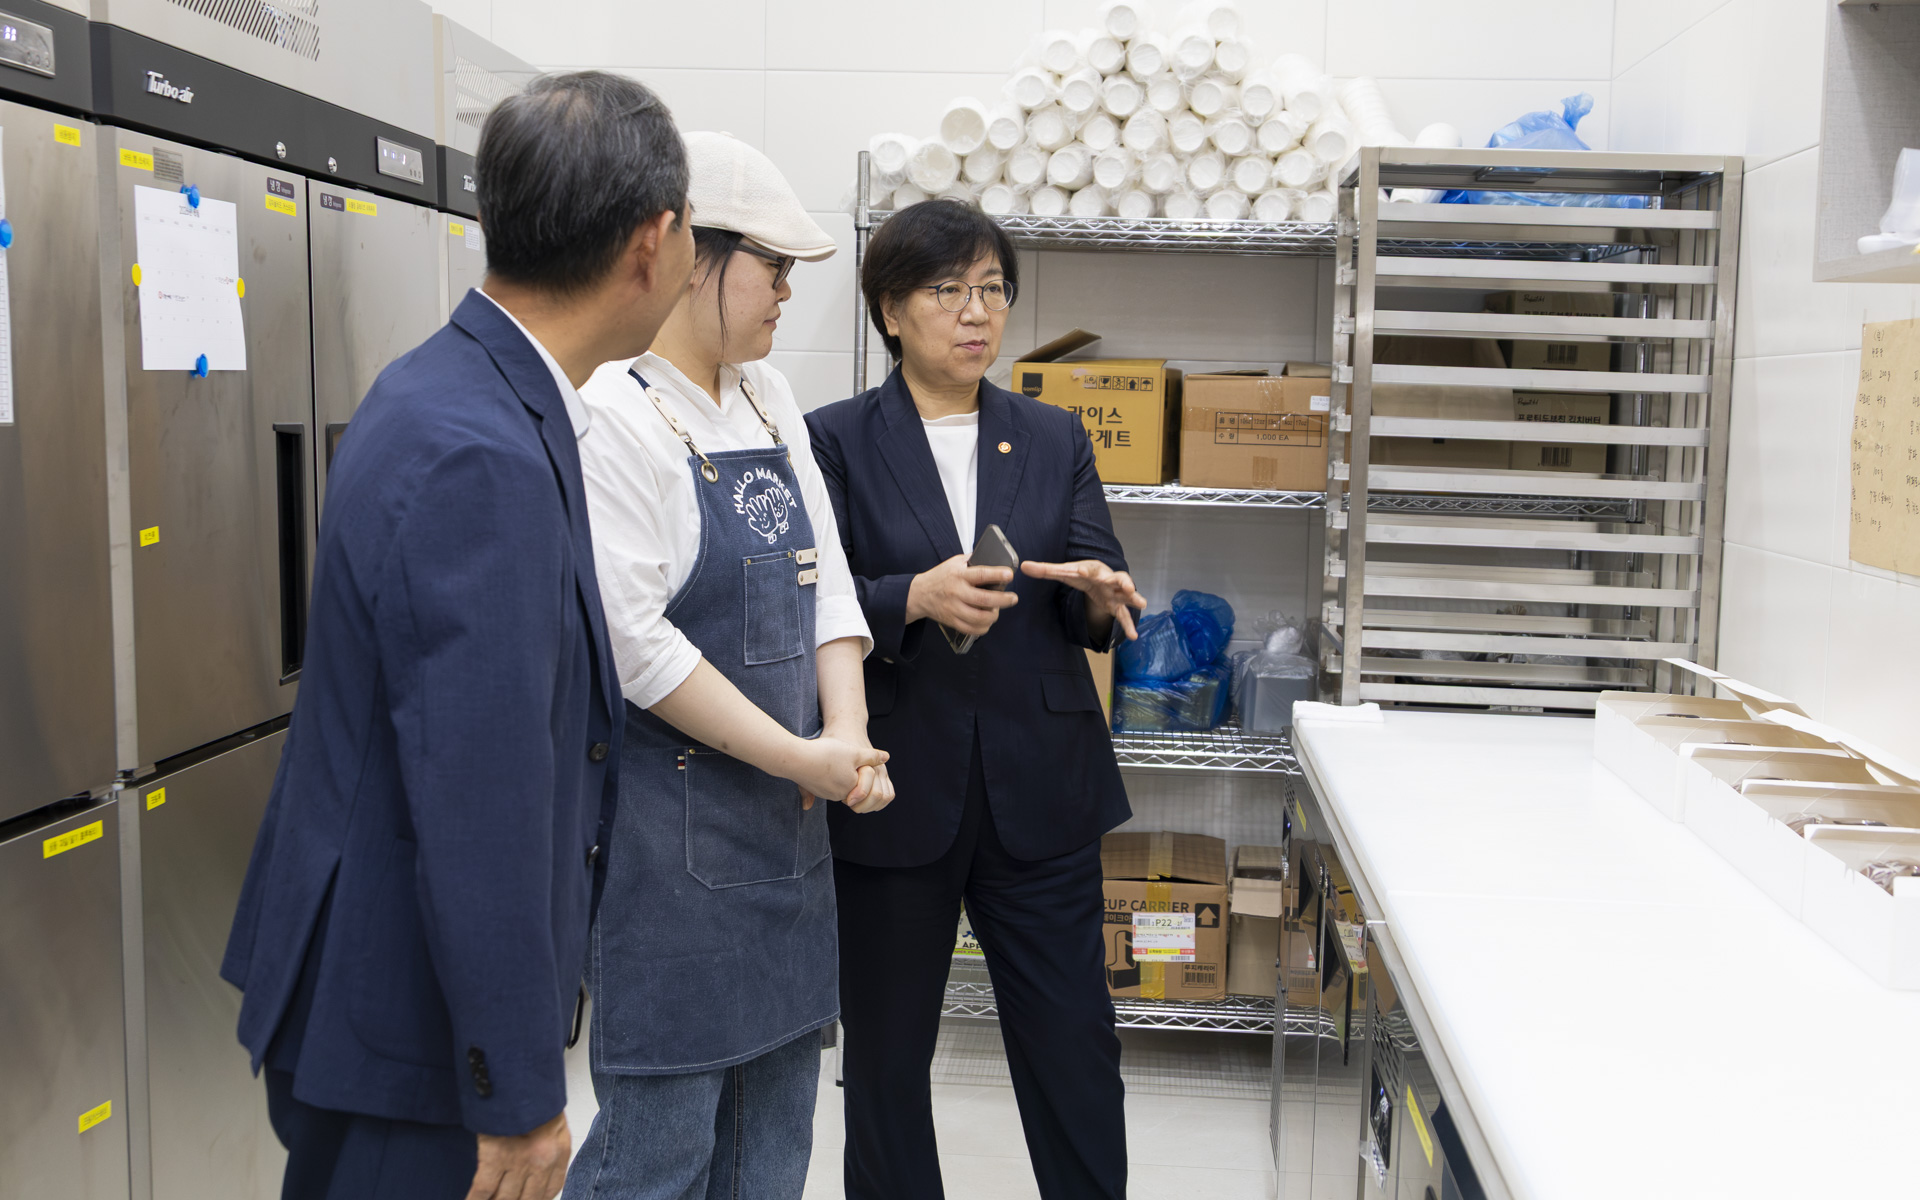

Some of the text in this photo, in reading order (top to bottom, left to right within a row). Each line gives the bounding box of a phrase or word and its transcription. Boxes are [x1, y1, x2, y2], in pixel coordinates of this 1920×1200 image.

[146, 70, 195, 104] Turbo air
[733, 468, 797, 514] HALLO MARKET
[1130, 899, 1189, 913] CARRIER
